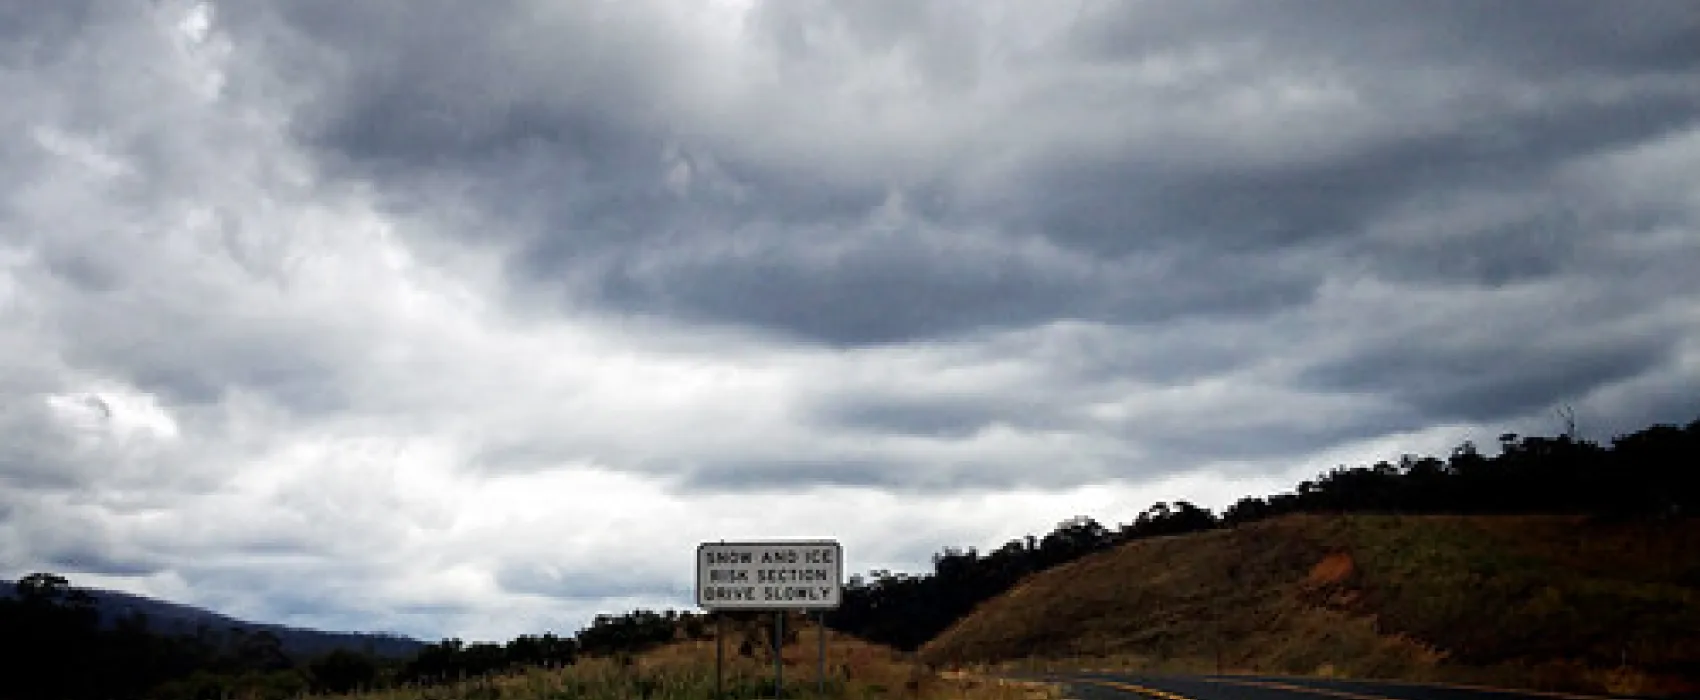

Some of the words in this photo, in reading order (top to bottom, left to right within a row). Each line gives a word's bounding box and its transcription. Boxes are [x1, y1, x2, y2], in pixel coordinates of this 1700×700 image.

[705, 551, 752, 564] SNOW
[761, 550, 799, 564] AND
[805, 549, 833, 564] ICE
[757, 569, 827, 583] SECTION
[704, 586, 755, 601] DRIVE
[764, 586, 832, 601] SLOWLY
